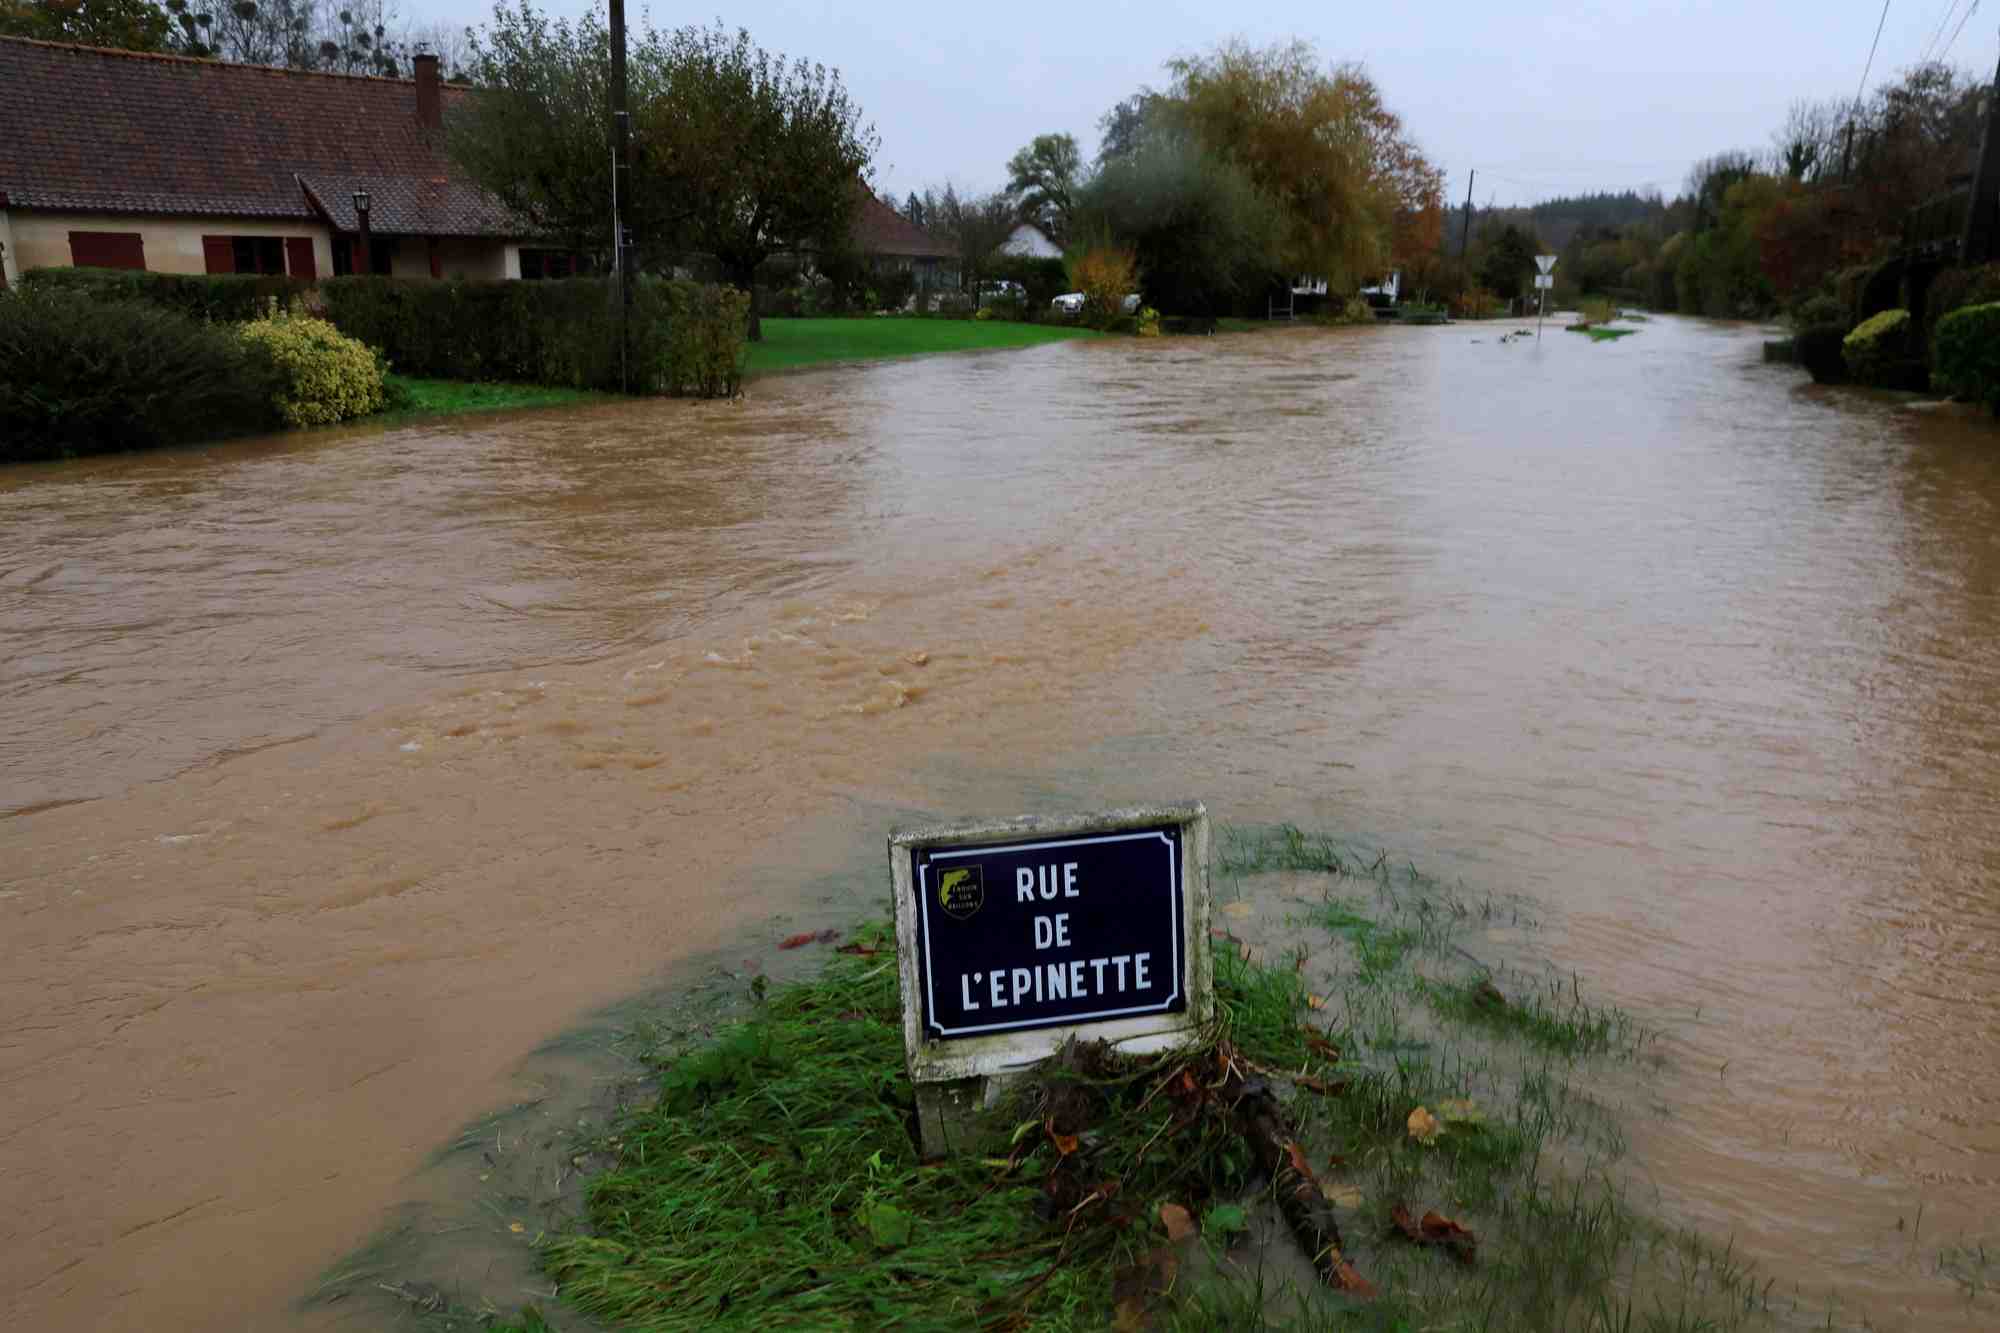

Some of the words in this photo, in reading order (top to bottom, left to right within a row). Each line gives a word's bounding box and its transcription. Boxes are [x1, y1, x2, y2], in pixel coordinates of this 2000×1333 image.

[1016, 862, 1080, 903] RUE
[1034, 912, 1072, 950] DE
[961, 952, 1152, 1011] L'EPINETTE
